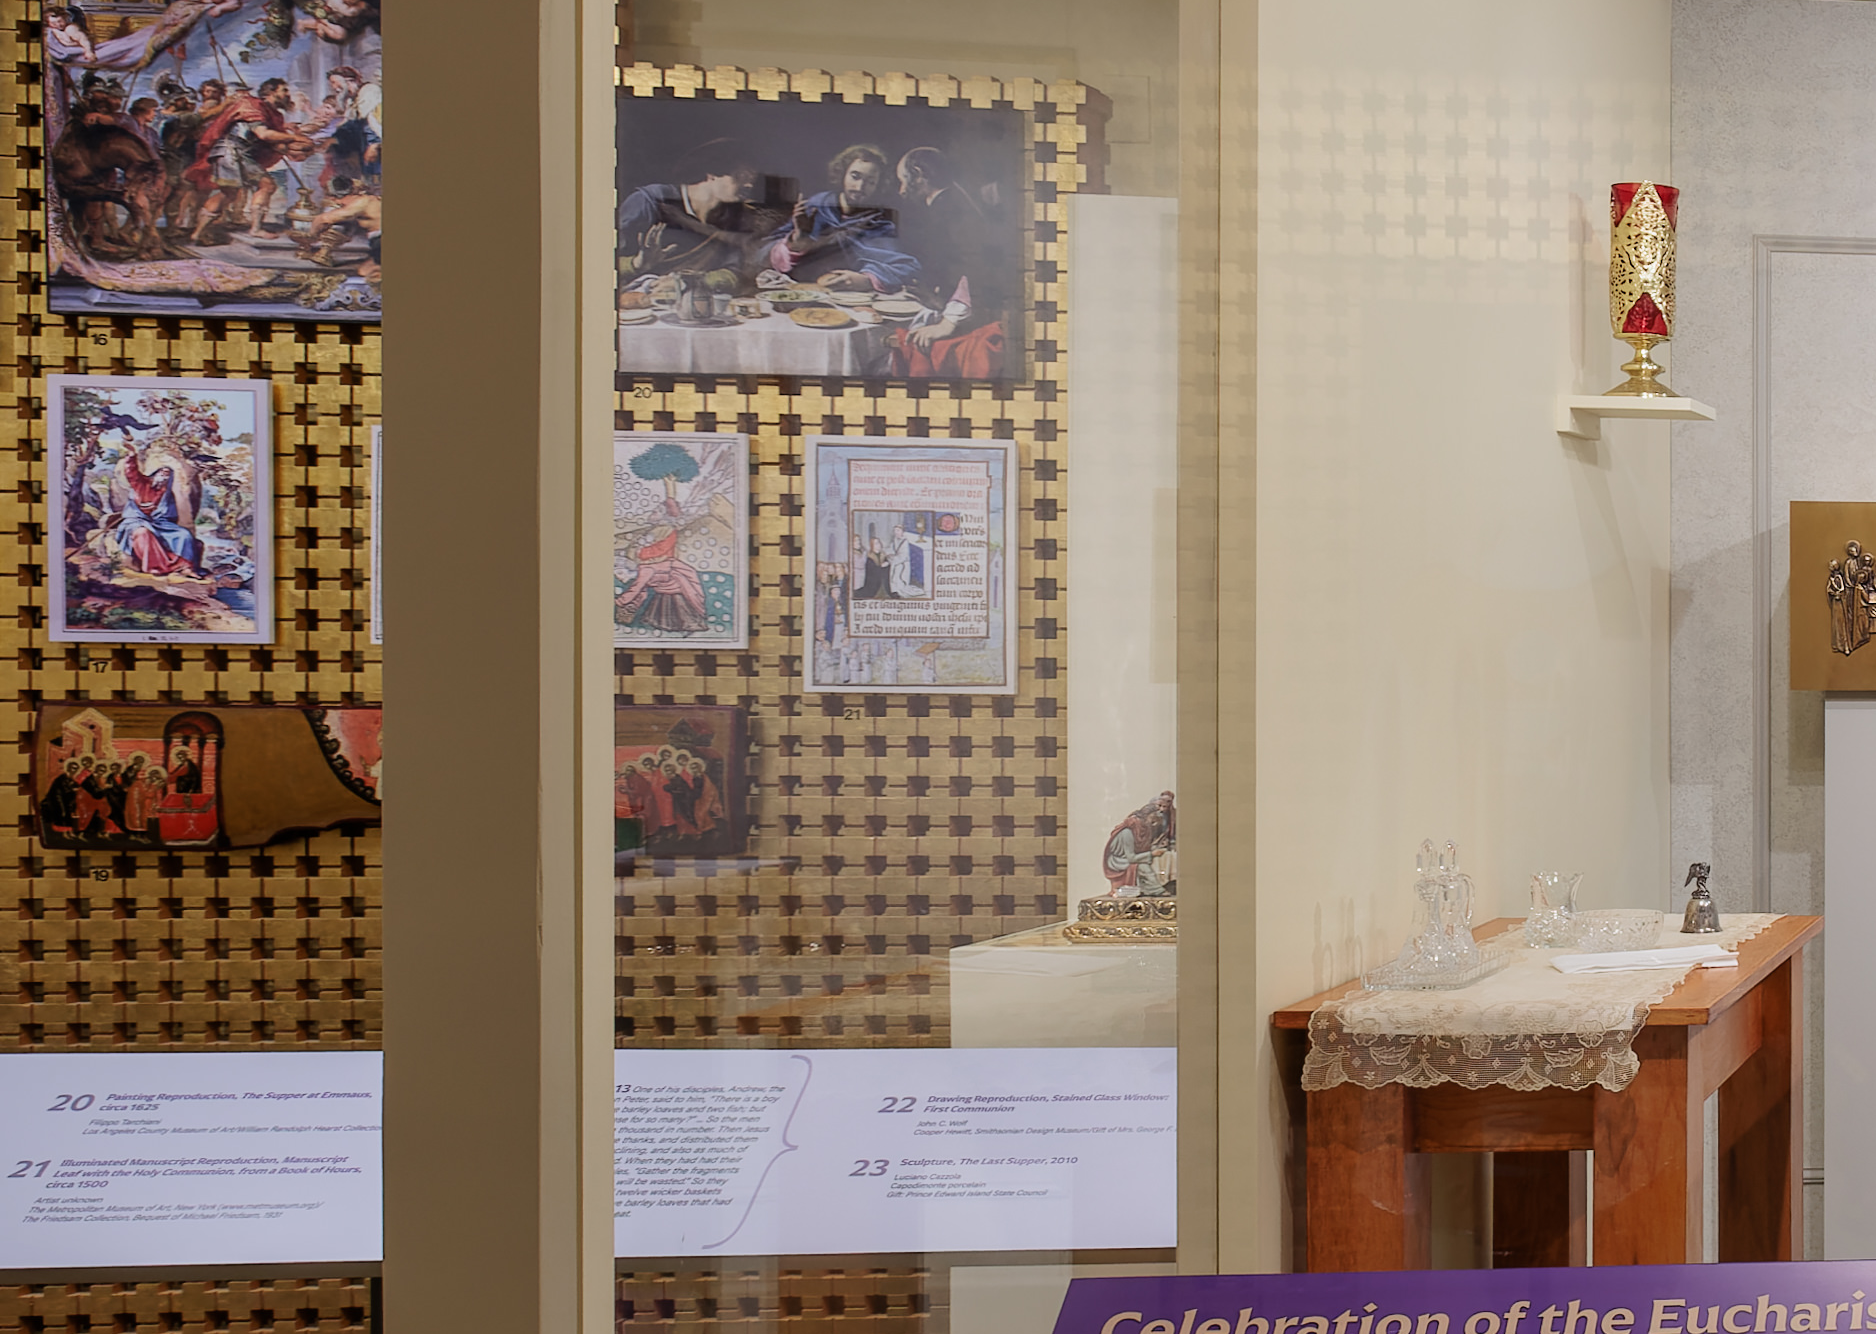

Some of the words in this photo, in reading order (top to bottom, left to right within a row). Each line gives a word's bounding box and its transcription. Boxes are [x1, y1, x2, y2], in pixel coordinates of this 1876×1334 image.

[91, 334, 108, 346] 16
[633, 386, 652, 399] 20
[92, 661, 108, 673] 17
[844, 709, 861, 720] 21
[92, 869, 109, 881] 19
[47, 1094, 95, 1112] 20
[106, 1093, 155, 1102] Painting
[155, 1092, 239, 1102] Reproduction,
[263, 1091, 306, 1101] Supper
[305, 1091, 320, 1099] at
[877, 1096, 917, 1113] 22
[927, 1094, 974, 1104] Drawing
[974, 1094, 1049, 1104] Reproduction,
[1051, 1094, 1094, 1102] Stained
[923, 1105, 948, 1113] First
[7, 1160, 52, 1179] 21
[60, 1158, 127, 1166] Illuminated
[130, 1157, 198, 1167] Manuscript
[198, 1156, 279, 1166] Reproduction,
[284, 1155, 349, 1166] Manuscript
[848, 1159, 890, 1177] 23
[899, 1158, 957, 1167] Sculpture,
[958, 1157, 979, 1165] The
[980, 1157, 1005, 1165] Last
[1005, 1156, 1049, 1166] Supper,
[1048, 1156, 1078, 1164] 2010
